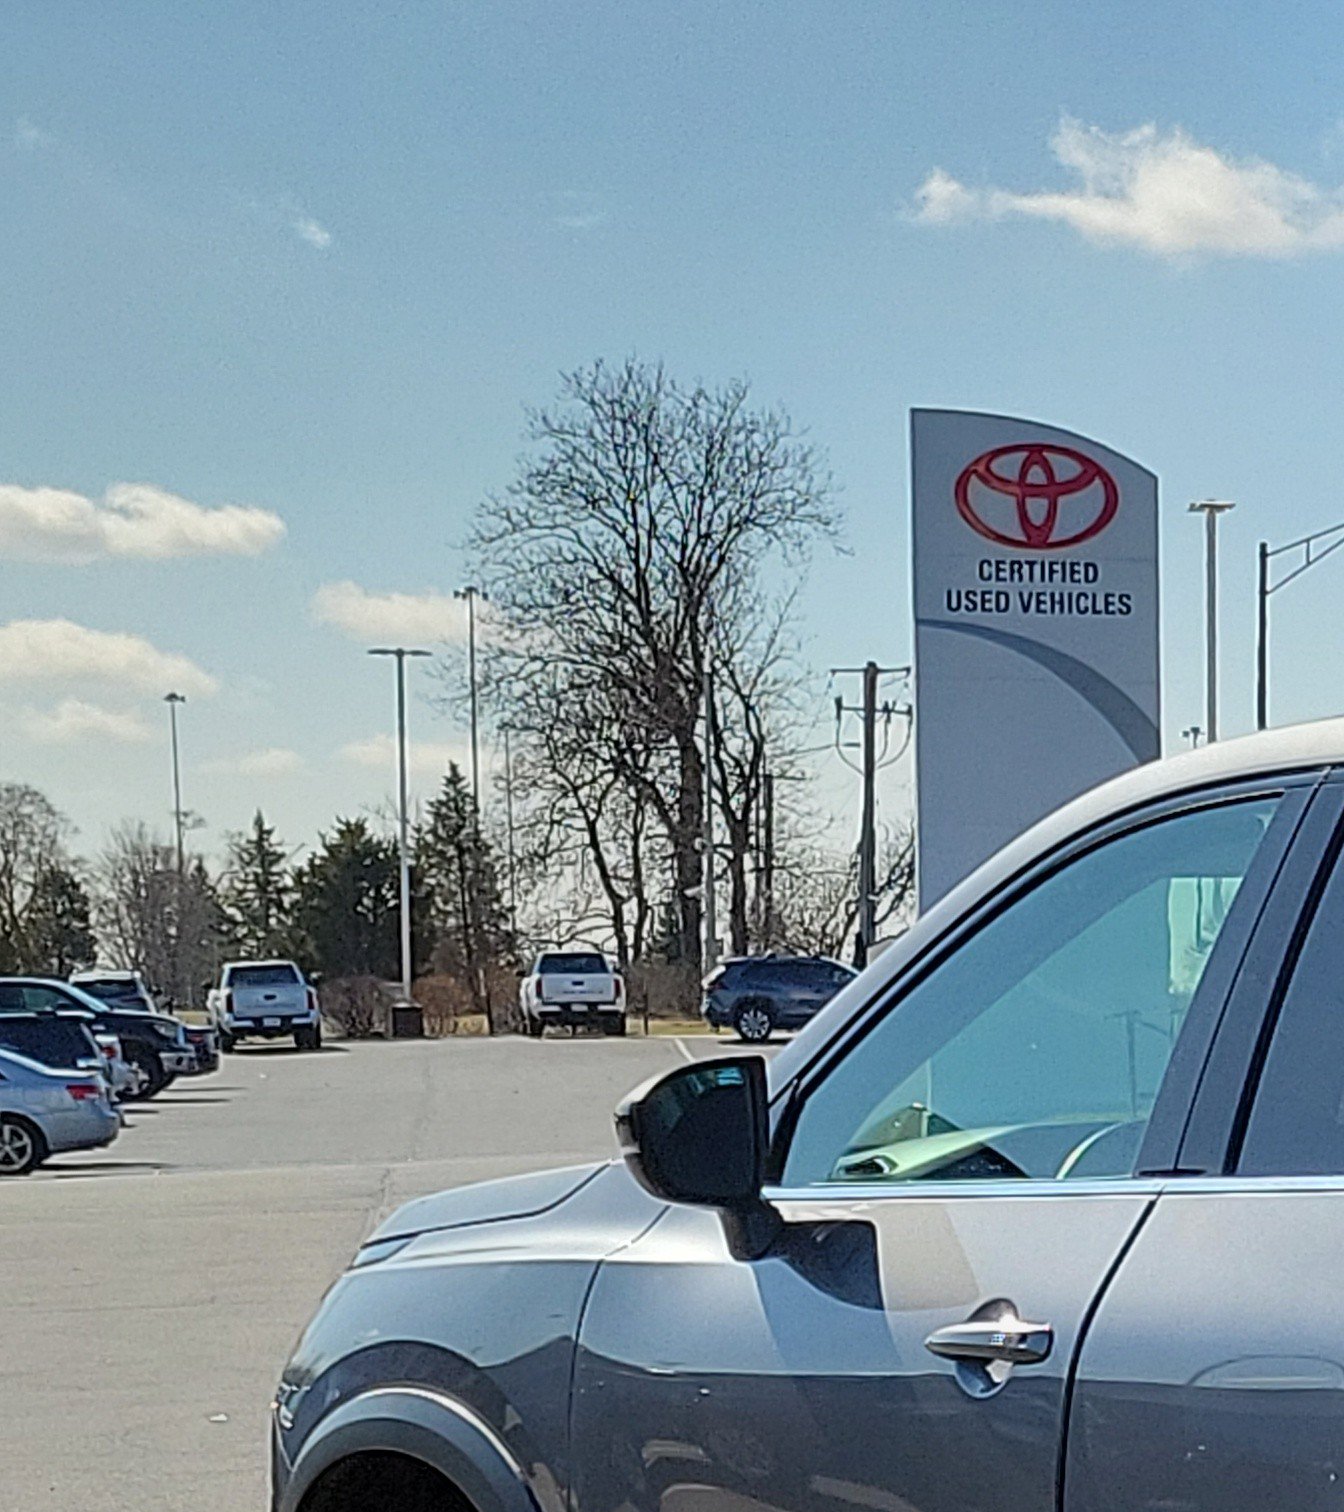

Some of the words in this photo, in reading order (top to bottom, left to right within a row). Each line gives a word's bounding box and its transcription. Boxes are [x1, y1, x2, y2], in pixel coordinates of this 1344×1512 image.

[978, 558, 1099, 584] CERTIFIED
[946, 589, 1010, 614] USED
[1018, 591, 1132, 615] VEHICLES
